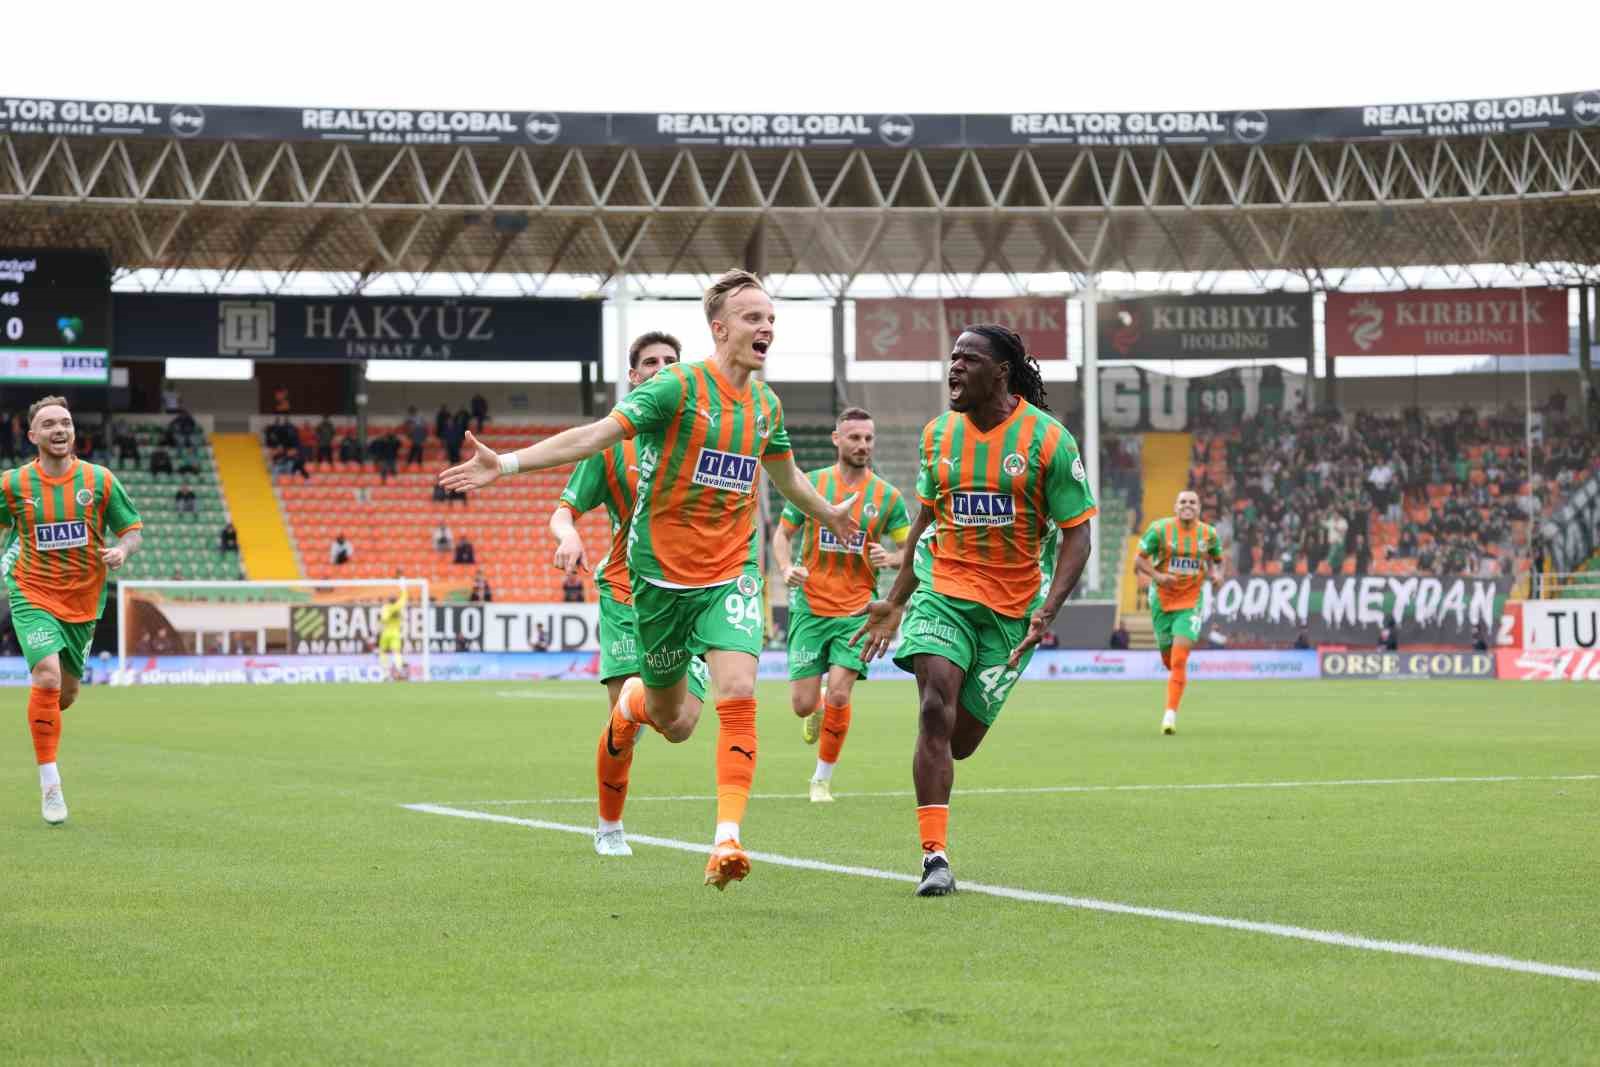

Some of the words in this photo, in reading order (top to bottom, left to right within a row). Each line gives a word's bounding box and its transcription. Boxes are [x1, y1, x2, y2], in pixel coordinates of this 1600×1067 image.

[61, 101, 162, 124] GLOBAL
[302, 109, 413, 130] REALTOR
[418, 111, 517, 133] GLOBAL
[1363, 102, 1469, 126] REALTOR
[1474, 96, 1565, 120] GLOBAL
[12, 122, 44, 133] REAL
[47, 123, 94, 135] ESTATE
[658, 113, 768, 135] REALTOR
[772, 115, 871, 135] GLOBAL
[1010, 114, 1122, 134] REALTOR
[1126, 112, 1224, 133] GLOBAL
[1427, 124, 1457, 135] REAL
[1461, 121, 1505, 133] ESTATE
[369, 132, 403, 143] REAL
[405, 133, 451, 144] ESTATE
[724, 136, 757, 147] REAL
[759, 136, 805, 147] ESTATE
[1078, 135, 1110, 145] REAL
[1113, 135, 1159, 145] ESTATE
[304, 299, 494, 340] HAKYÜZ
[911, 306, 1060, 331] KRBIYIK
[1151, 304, 1300, 330] KIRBIYIK
[1395, 301, 1547, 326] KIRBIYIK
[705, 455, 755, 479] TAV
[957, 498, 1009, 515] TAV
[39, 524, 84, 540] TAV
[725, 593, 762, 628] 94
[1322, 577, 1497, 629] MEYDAN
[495, 613, 600, 651] TUD
[1324, 653, 1399, 674] ORSE
[1409, 653, 1492, 674] GOLD
[978, 664, 1020, 702] 42
